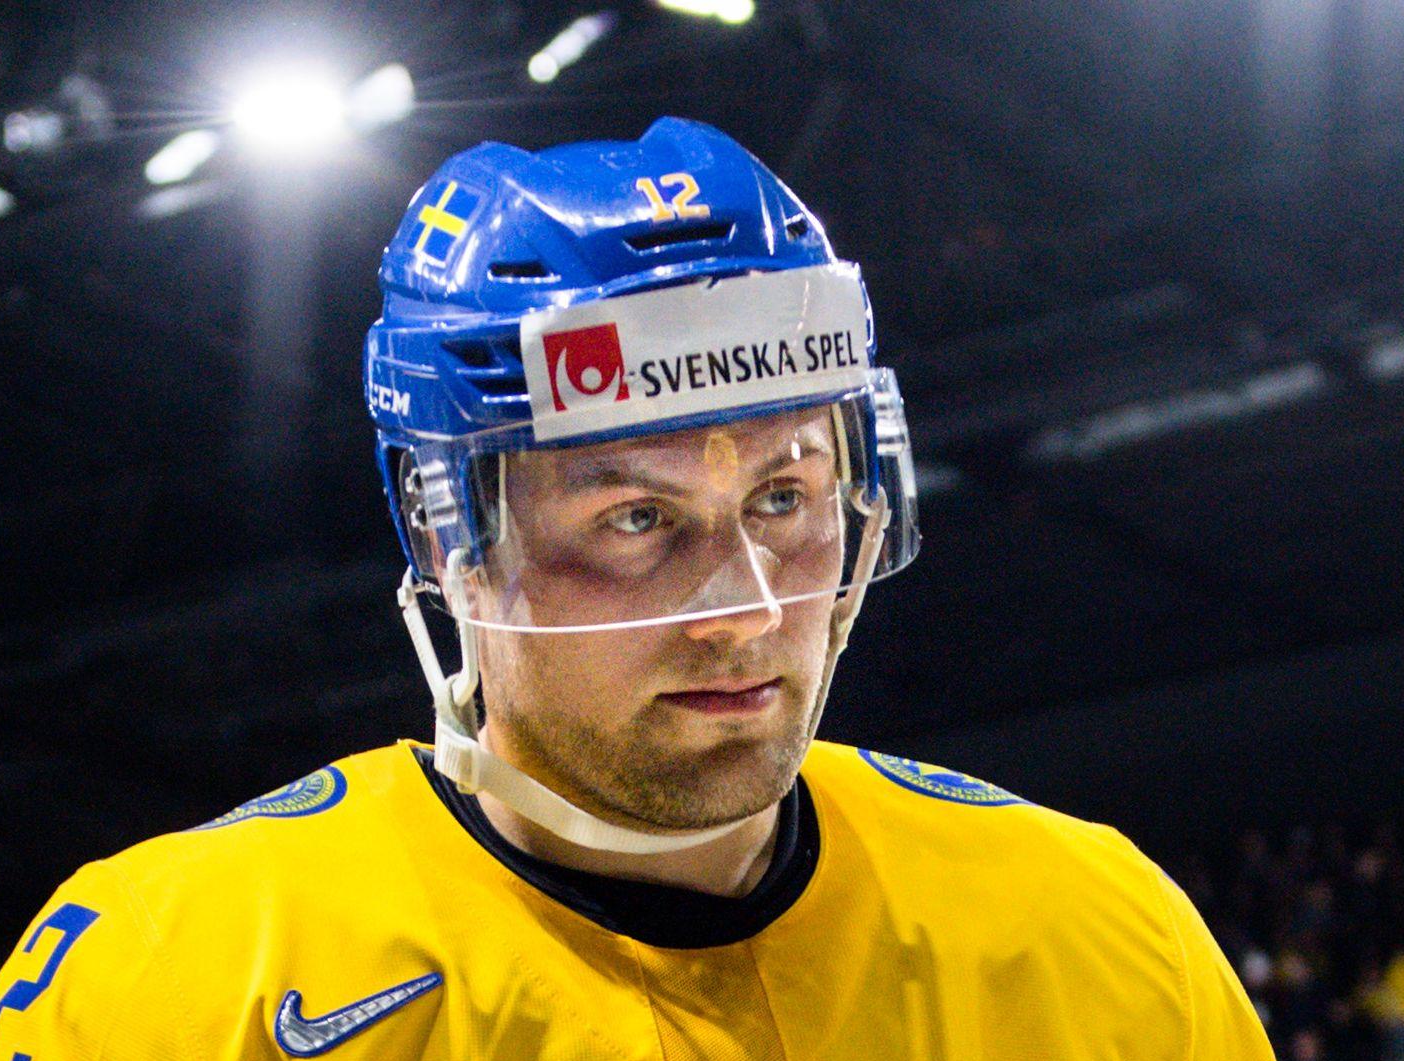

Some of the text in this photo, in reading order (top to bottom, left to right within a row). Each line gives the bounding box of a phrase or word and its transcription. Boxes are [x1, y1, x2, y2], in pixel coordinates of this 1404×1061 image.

[636, 172, 711, 222] 12
[640, 330, 859, 398] SVENSKA SPEL
